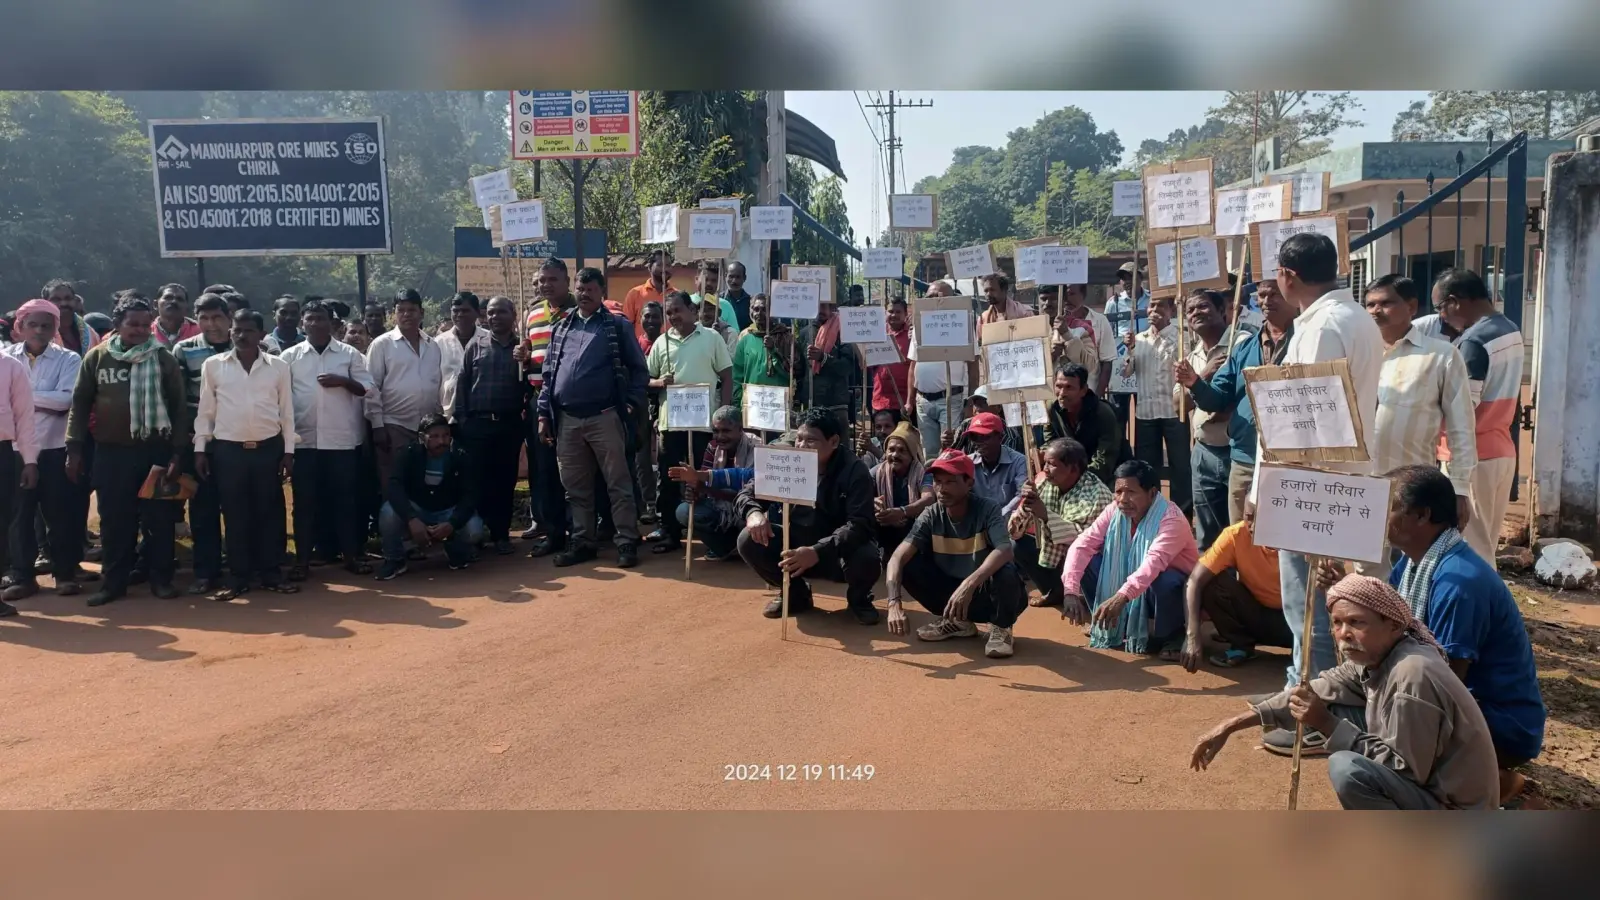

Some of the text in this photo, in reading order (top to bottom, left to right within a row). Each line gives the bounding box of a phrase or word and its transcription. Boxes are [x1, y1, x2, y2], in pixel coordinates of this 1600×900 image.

[190, 141, 339, 159] MANOHARPUR ORE MINES
[344, 142, 378, 154] ISO
[176, 161, 191, 169] SAIL
[238, 160, 280, 176] CHIRIA
[164, 185, 182, 205] AN
[184, 185, 208, 204] ISO
[164, 210, 175, 229] &
[177, 209, 199, 229] ISO
[276, 207, 340, 227] CERTIFIED
[343, 207, 380, 226] MINES
[995, 361, 1009, 372] होश
[1021, 356, 1039, 368] आओ
[1297, 384, 1327, 396] परिवार
[1265, 400, 1337, 415] को बेघर होने से
[793, 455, 801, 463] की
[1280, 478, 1366, 498] हज़ारों परिवार
[1271, 495, 1371, 519] को बेघर होने से
[1302, 520, 1335, 535] बचाएँ
